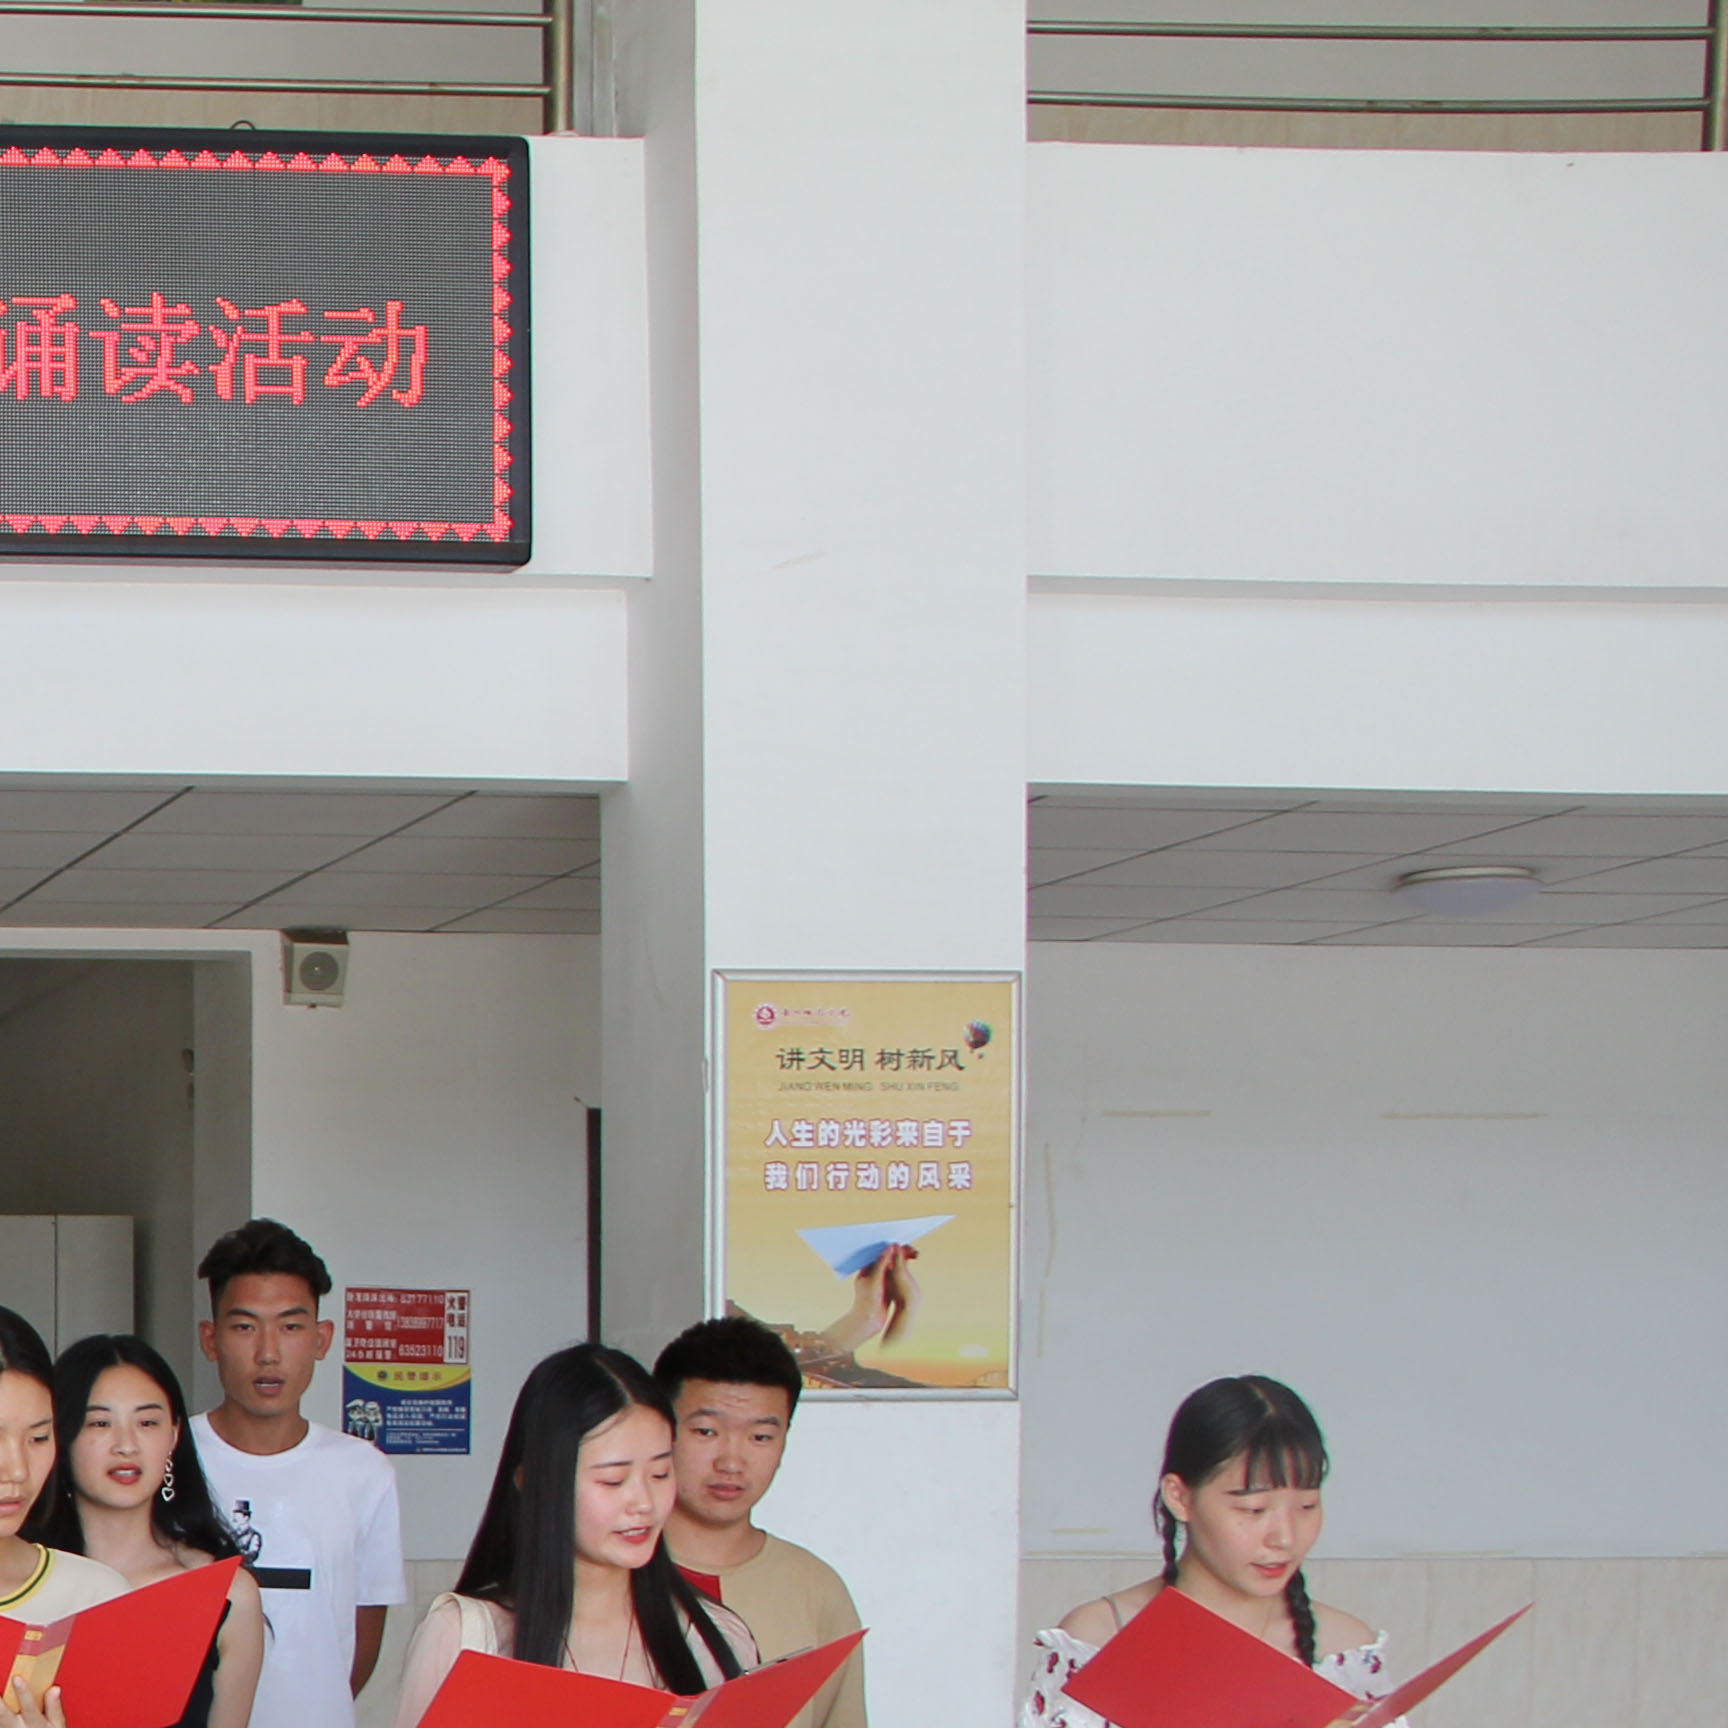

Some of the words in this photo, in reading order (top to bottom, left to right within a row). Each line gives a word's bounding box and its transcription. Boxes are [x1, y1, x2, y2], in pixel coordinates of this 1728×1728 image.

[776, 1048, 865, 1071] 讲文明
[875, 1048, 965, 1071] 树新风
[764, 1119, 972, 1148] 人生的光彩来自于
[764, 1161, 972, 1190] 我们行动的风采
